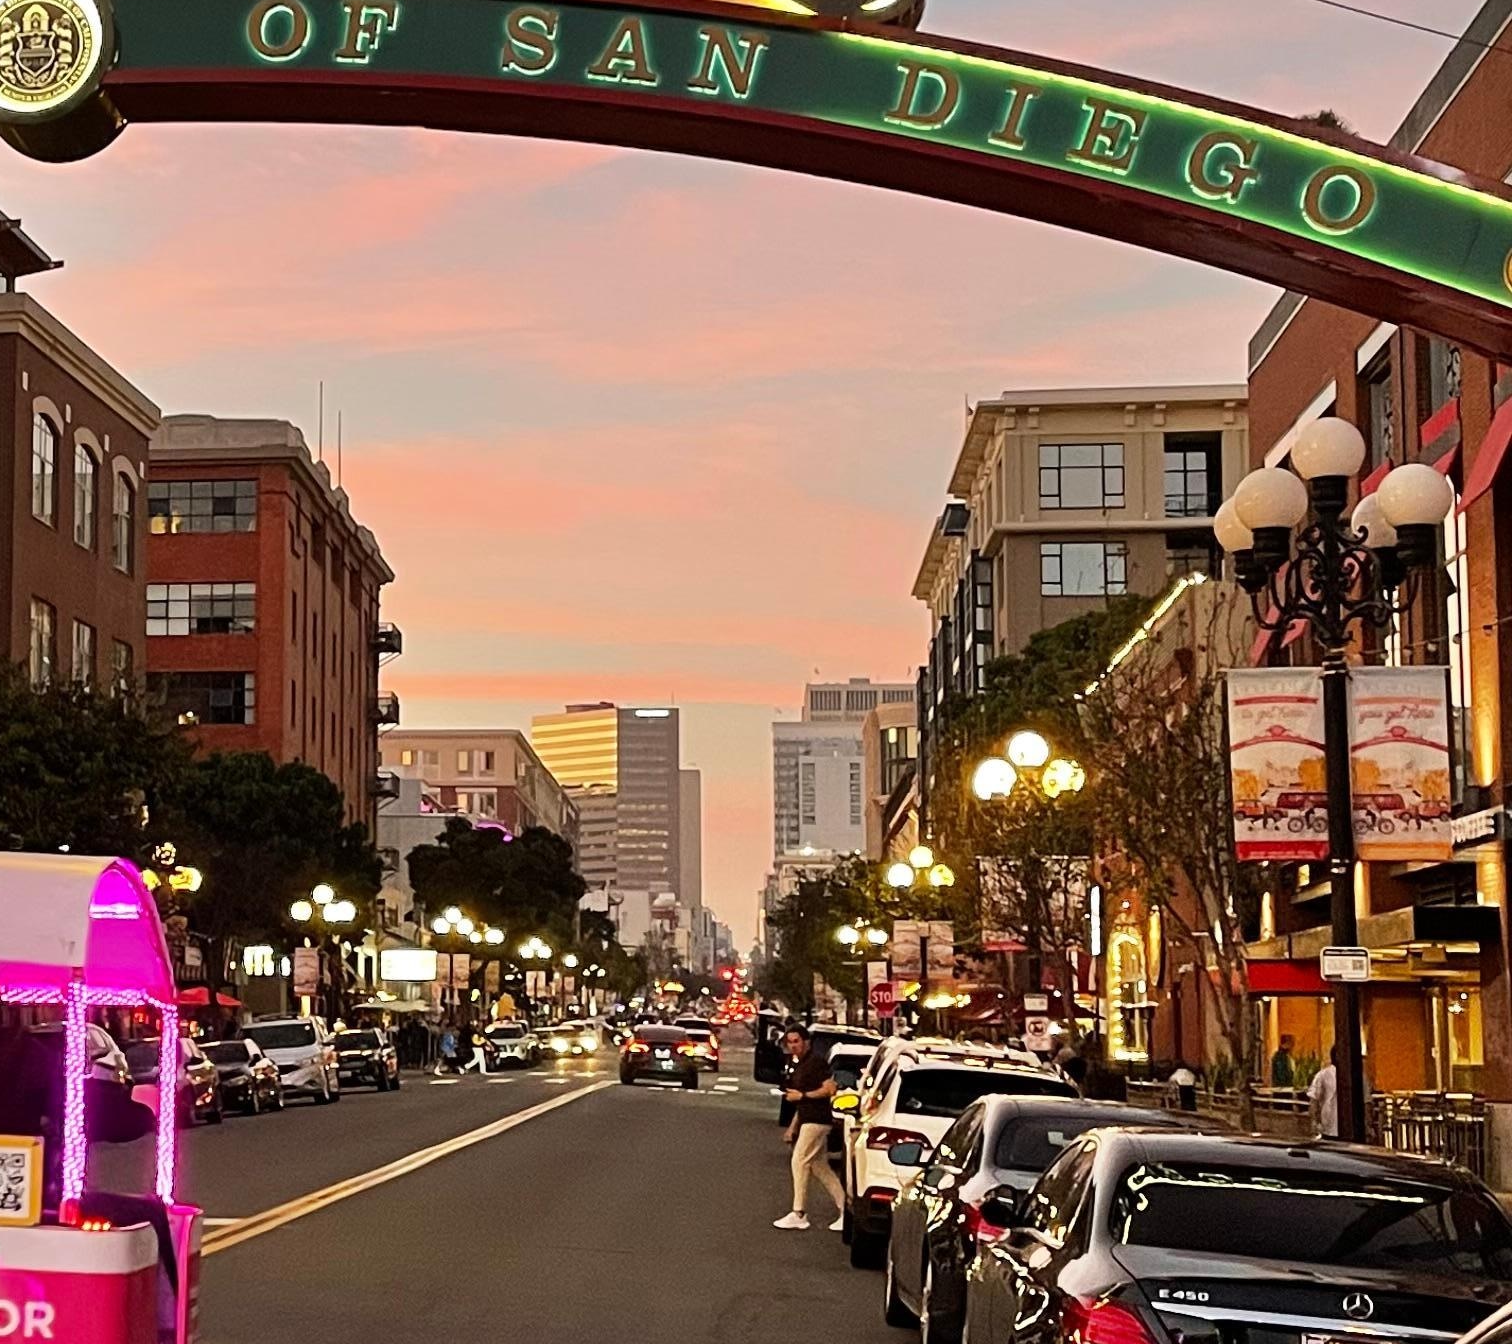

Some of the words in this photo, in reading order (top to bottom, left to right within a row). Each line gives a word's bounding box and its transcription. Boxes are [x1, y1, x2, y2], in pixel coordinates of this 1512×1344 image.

[500, 6, 767, 101] SAN
[883, 57, 1378, 237] DIEGO
[871, 991, 892, 1003] STO
